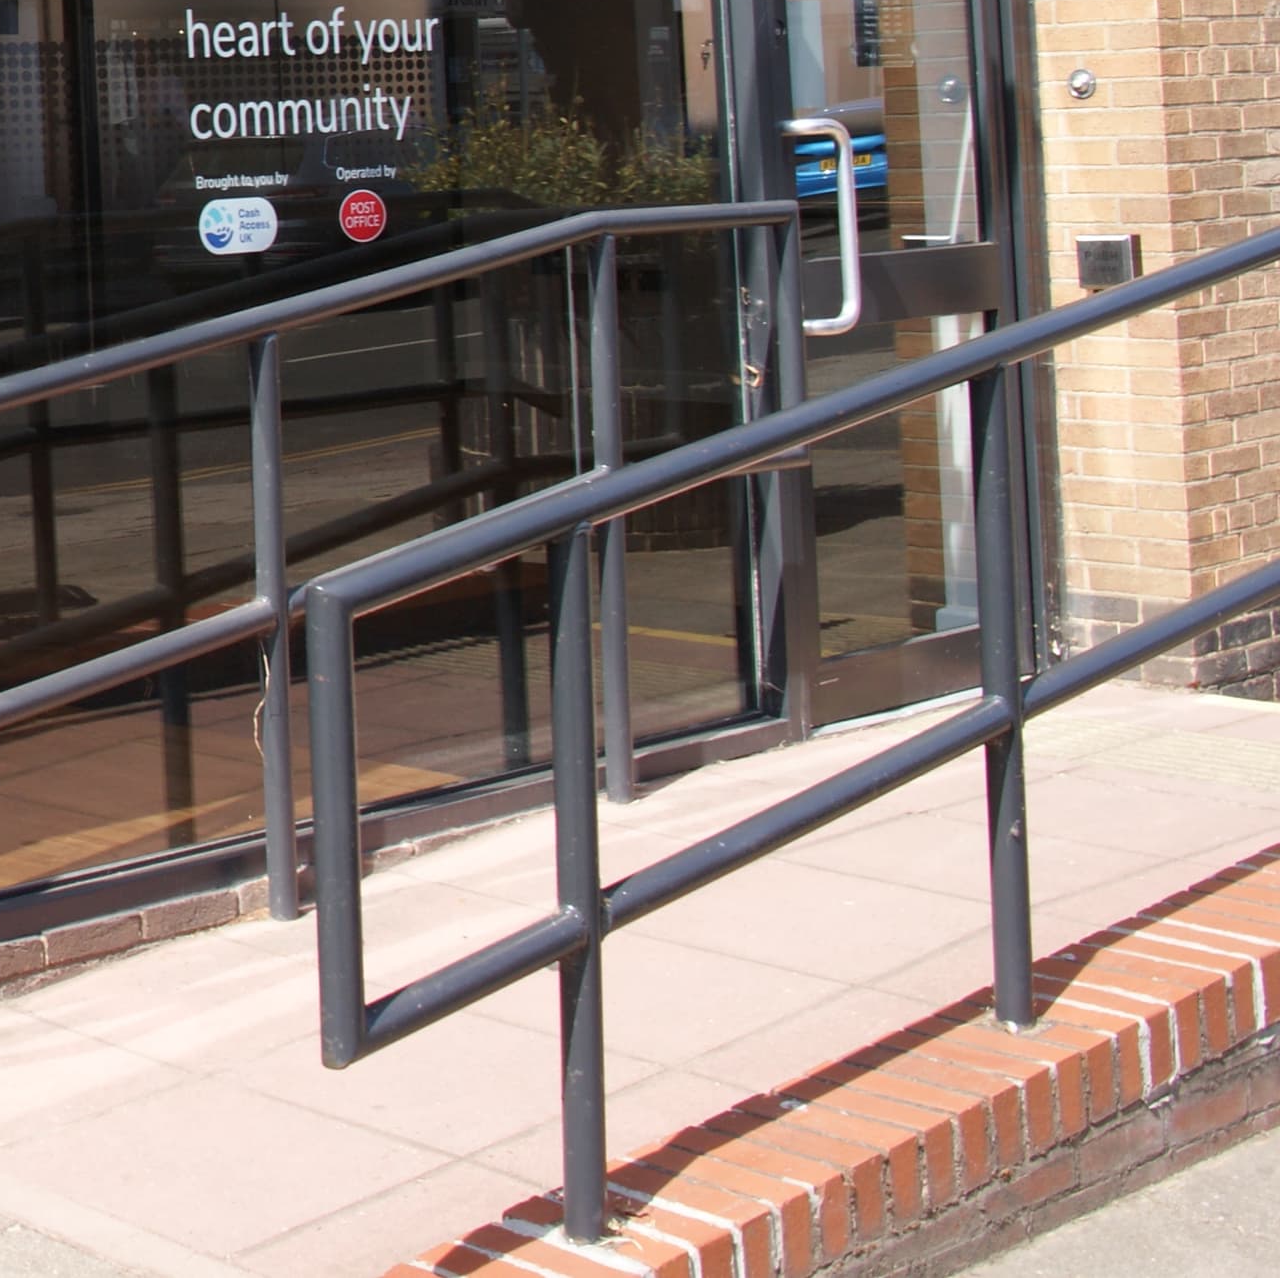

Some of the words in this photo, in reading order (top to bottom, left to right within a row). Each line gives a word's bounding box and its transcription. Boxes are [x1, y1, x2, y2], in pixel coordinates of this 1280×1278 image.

[185, 9, 294, 58] heart
[306, 6, 345, 54] of
[354, 17, 439, 64] your
[190, 84, 411, 141] community
[336, 166, 381, 181] Operated
[383, 164, 396, 179] by
[195, 175, 239, 191] Brought
[241, 175, 253, 186] to
[255, 175, 274, 190] you
[276, 171, 289, 186] by
[238, 208, 261, 219] Cash
[350, 202, 377, 215] POST
[238, 220, 271, 231] Access
[345, 214, 381, 229] OFFICE
[239, 233, 253, 243] UK
